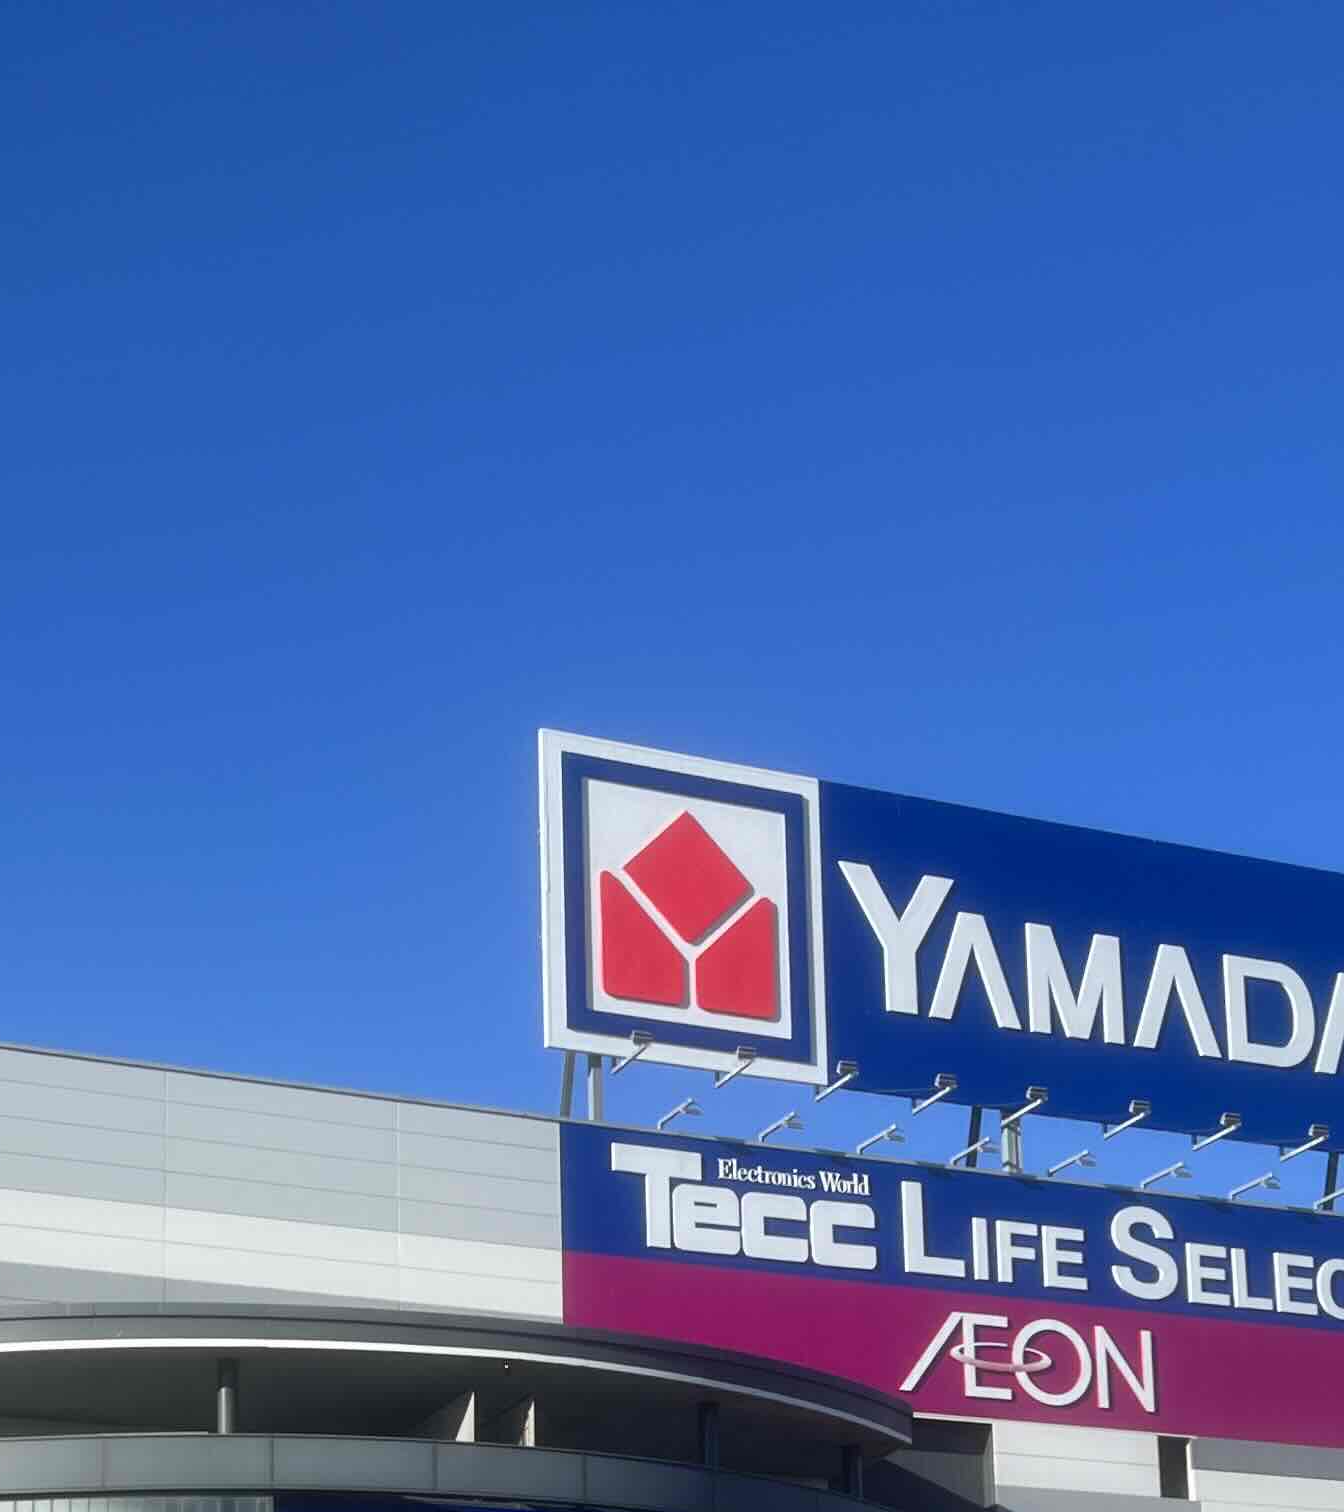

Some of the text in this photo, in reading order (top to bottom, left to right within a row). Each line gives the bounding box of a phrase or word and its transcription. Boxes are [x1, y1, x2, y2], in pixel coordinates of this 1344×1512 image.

[611, 1142, 878, 1271] Tecc
[901, 1180, 1089, 1291] LIFE
[718, 1158, 871, 1197] Electronics World
